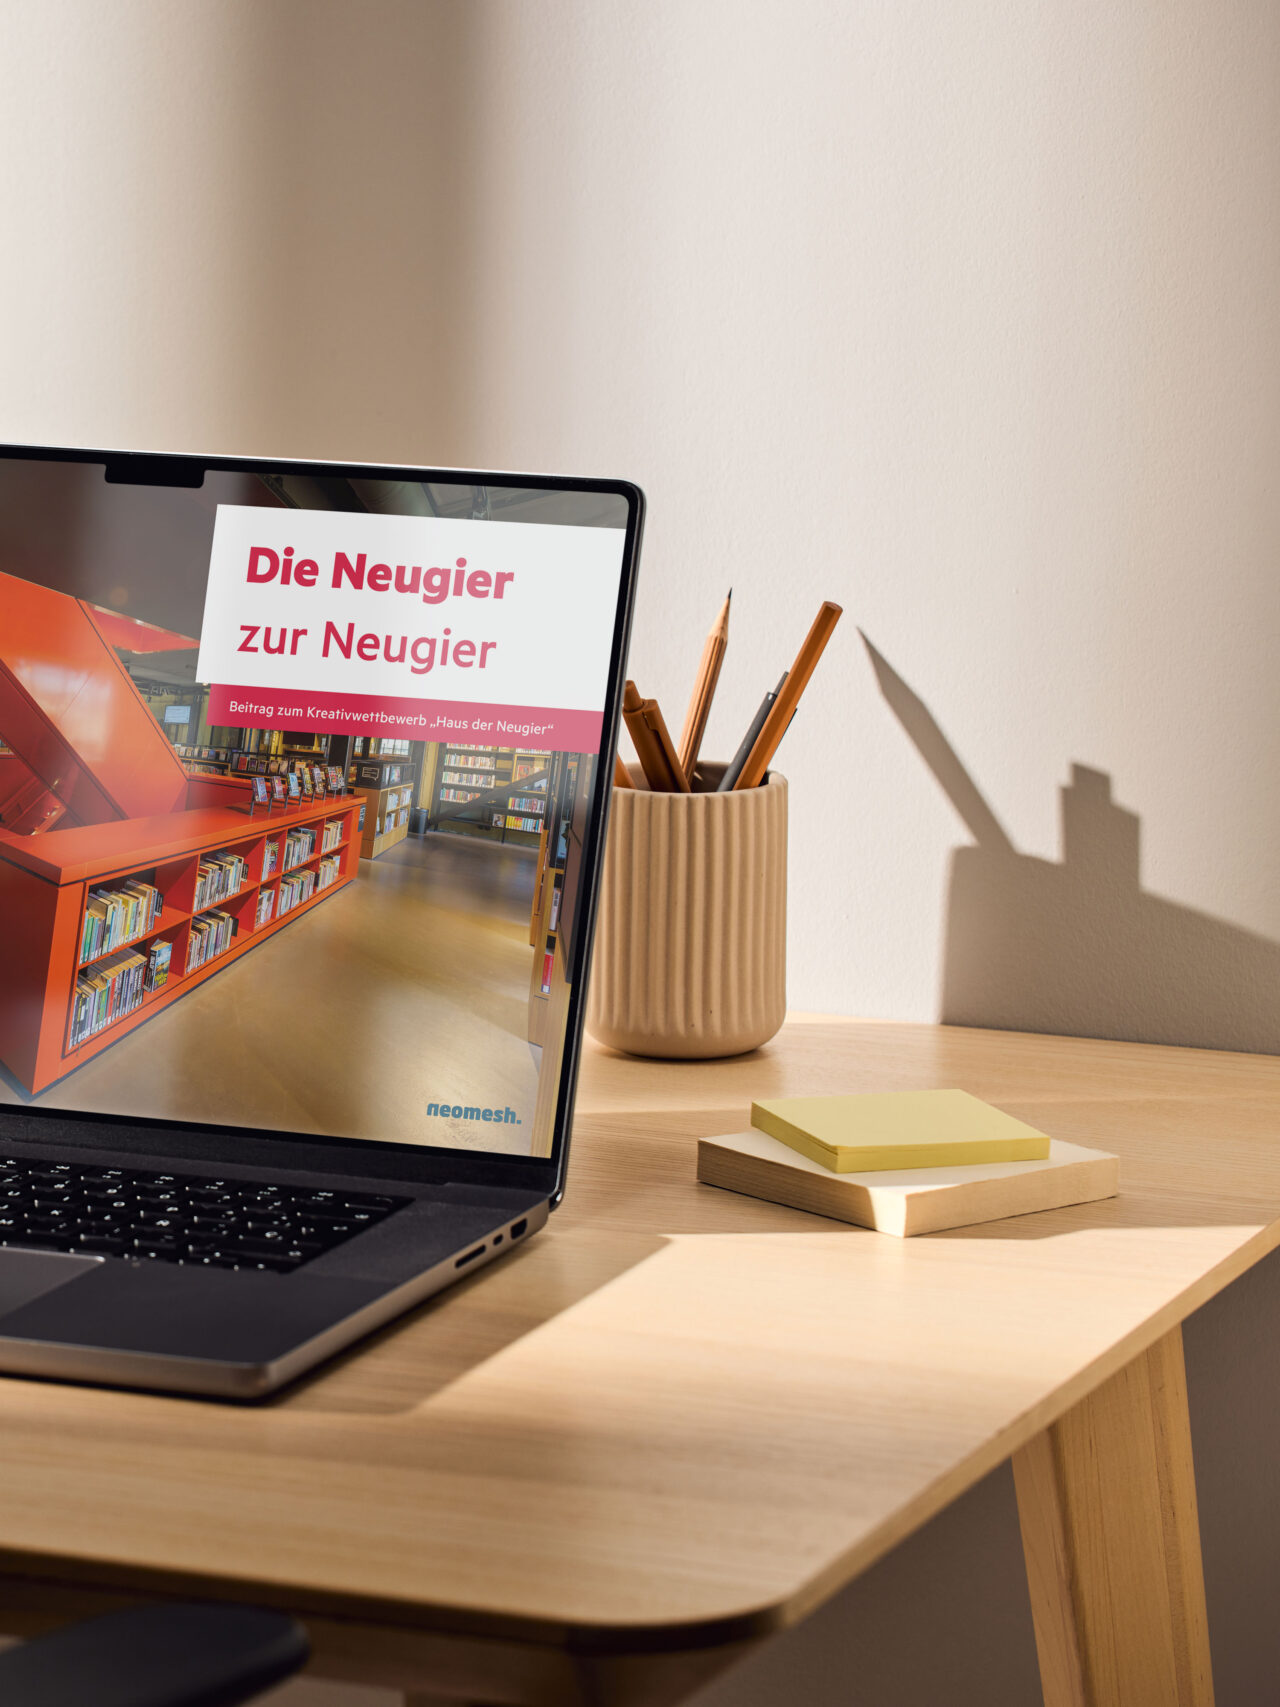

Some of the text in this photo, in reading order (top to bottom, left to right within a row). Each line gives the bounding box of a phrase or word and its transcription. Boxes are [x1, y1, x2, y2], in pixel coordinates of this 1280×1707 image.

[245, 545, 515, 604] Die Neugier
[236, 620, 497, 675] zur Neugier
[228, 700, 274, 718] Beitrag
[277, 706, 303, 718] zum
[306, 706, 427, 727] Kreativwettbewerb
[471, 718, 494, 731] der
[426, 1103, 522, 1125] neomesh.
